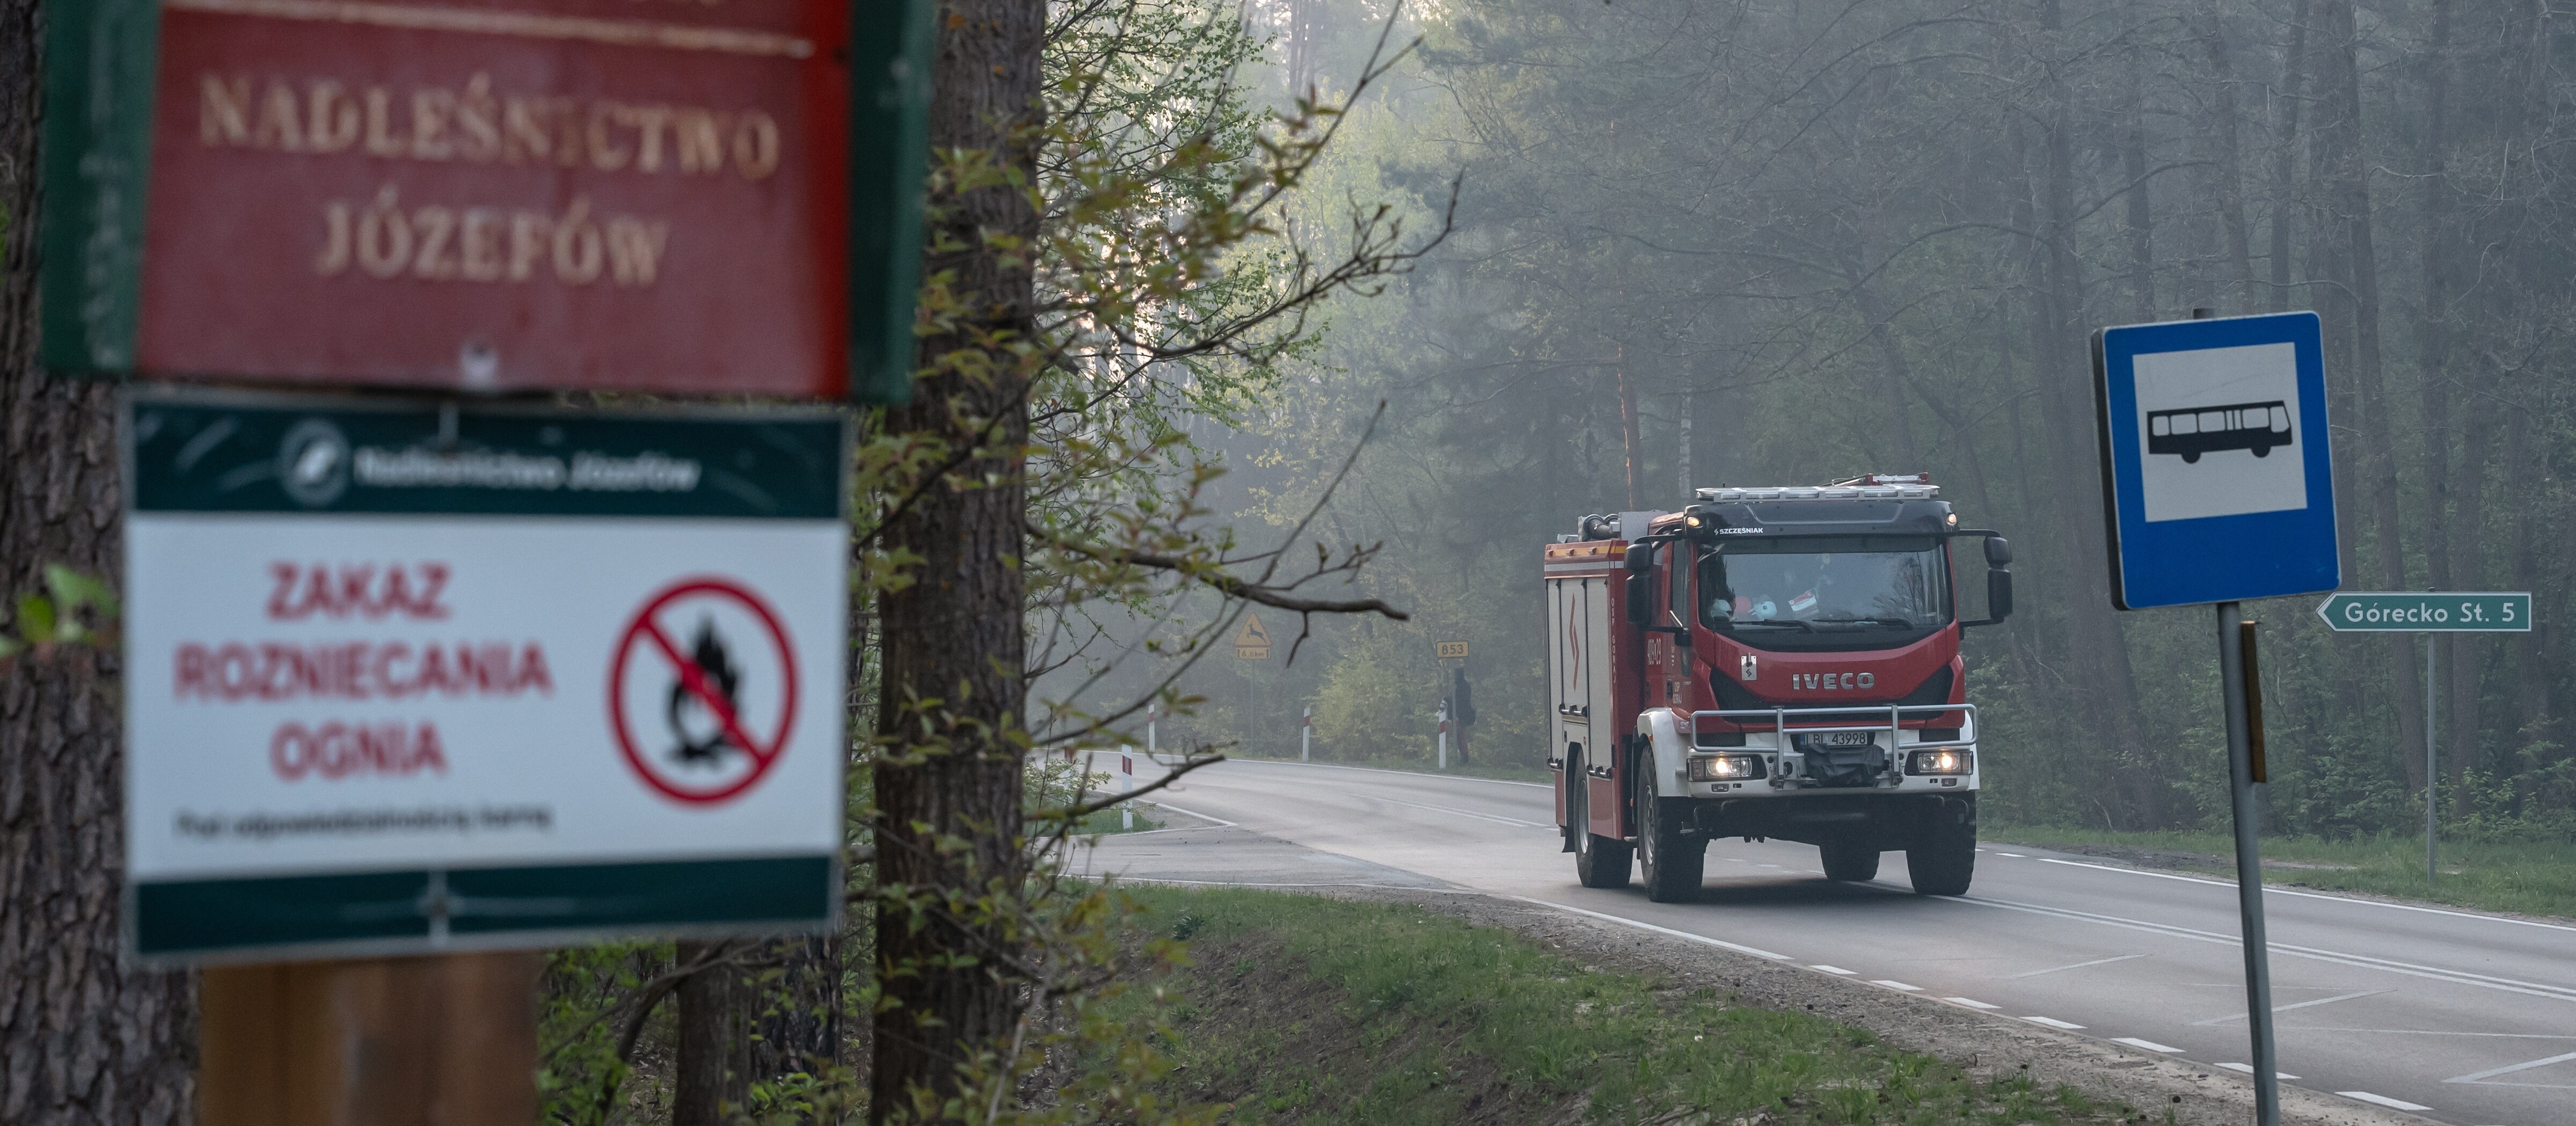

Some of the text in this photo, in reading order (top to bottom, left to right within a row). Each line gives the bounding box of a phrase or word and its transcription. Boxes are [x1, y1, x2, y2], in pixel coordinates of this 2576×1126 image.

[200, 70, 778, 180] NADLEŚNICTWO
[318, 184, 670, 286] JÓZEFÓW
[265, 560, 455, 623] ZAKAZ
[2345, 602, 2515, 623] Górecko St. 5
[173, 640, 556, 703] ROZNIECANIA
[1442, 644, 1464, 654] 853
[1793, 672, 1874, 690] IVECO
[270, 719, 449, 784] OGNIA
[1831, 733, 1866, 745] 43998
